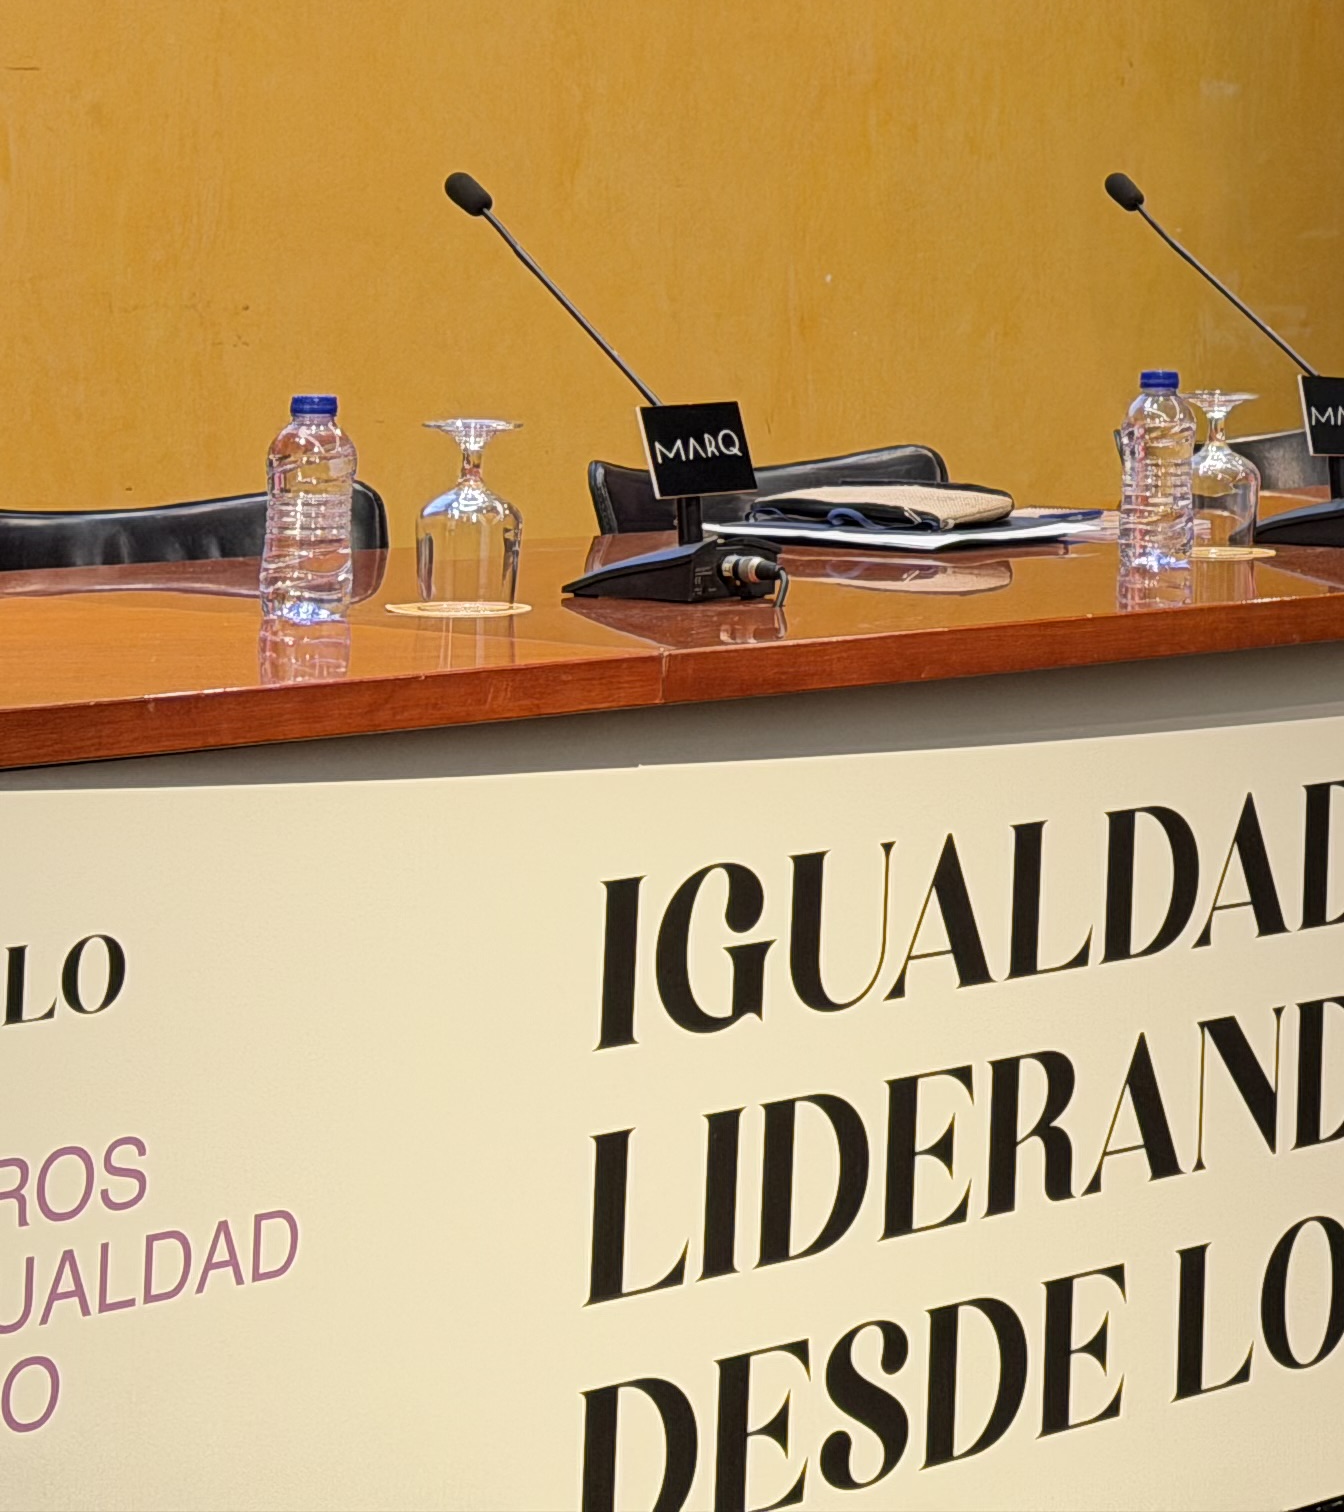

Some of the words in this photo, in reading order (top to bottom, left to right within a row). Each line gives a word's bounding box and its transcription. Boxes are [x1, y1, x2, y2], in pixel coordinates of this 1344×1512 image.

[654, 429, 743, 464] MARQ
[2, 933, 126, 1028] LO
[1, 1354, 60, 1433] O
[578, 1263, 1128, 1512] DESDE
